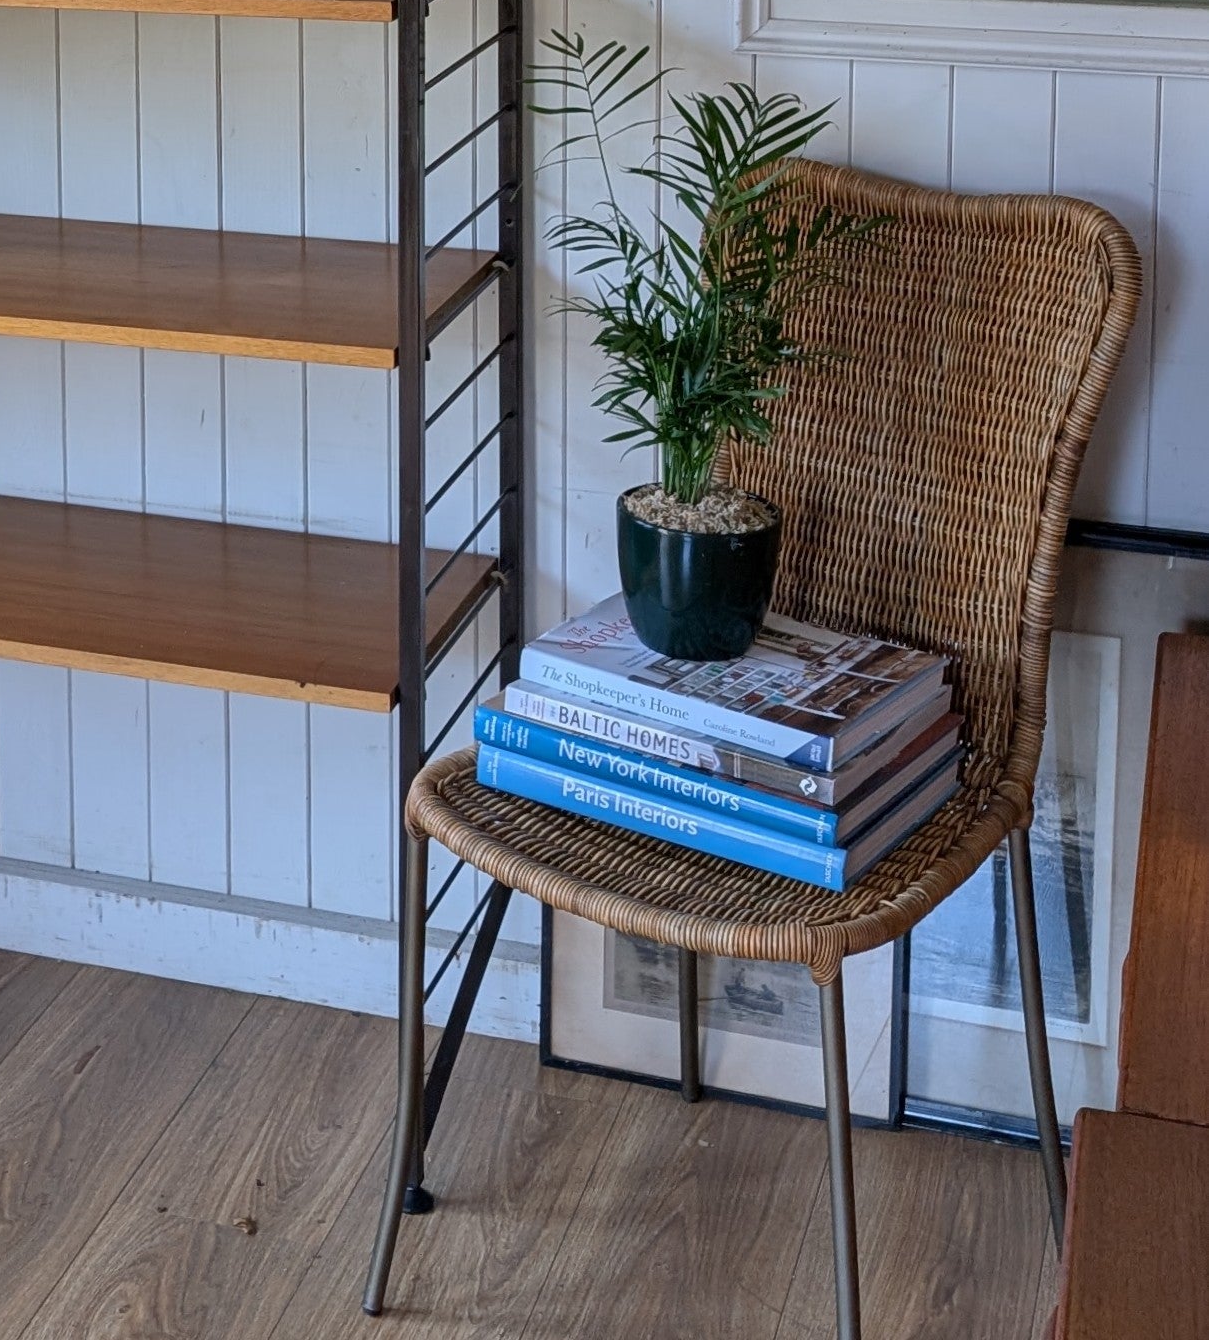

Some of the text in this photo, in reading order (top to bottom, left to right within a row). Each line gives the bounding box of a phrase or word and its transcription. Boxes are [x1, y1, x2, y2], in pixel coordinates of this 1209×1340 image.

[559, 616, 632, 653] The Shopke
[542, 665, 690, 721] The Shopkeeper's Home
[558, 705, 621, 739] BALTIC
[627, 725, 691, 760] HOMES
[703, 718, 776, 747] Caroline Rowland
[558, 738, 740, 812] New York Interiors
[562, 776, 699, 836] Paris Interiors
[824, 852, 834, 884] TASCHEN
